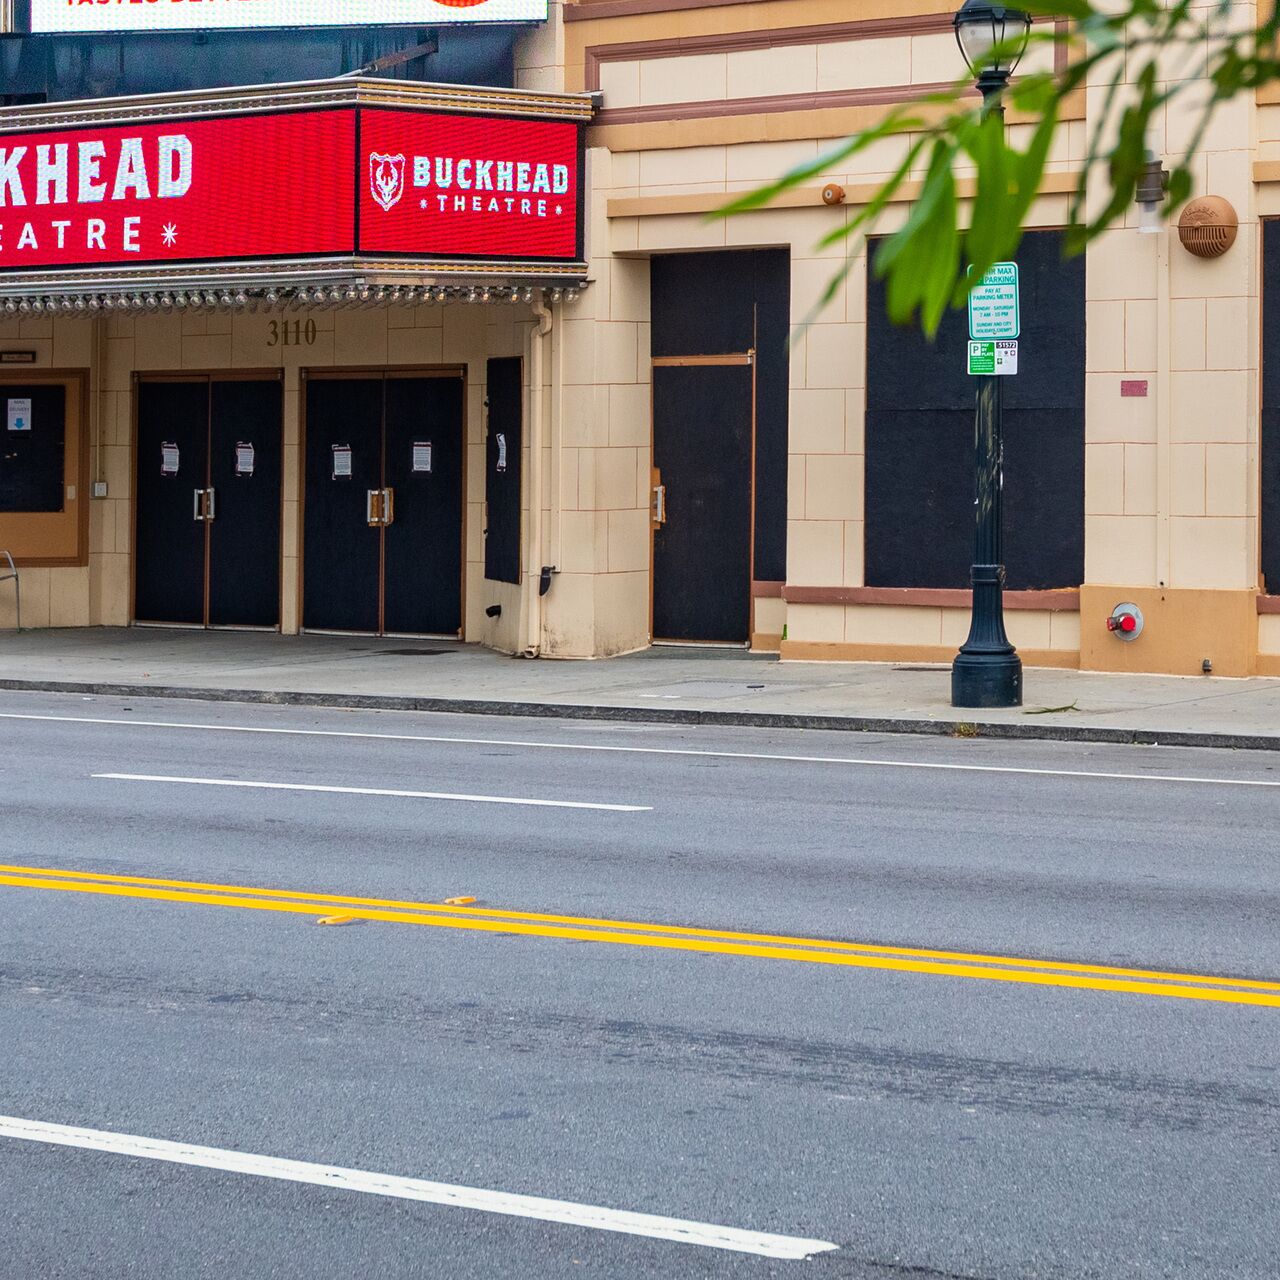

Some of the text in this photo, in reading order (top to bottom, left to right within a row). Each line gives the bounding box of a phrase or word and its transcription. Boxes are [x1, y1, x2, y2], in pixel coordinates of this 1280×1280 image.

[413, 155, 569, 195] BUCKHEAD
[437, 194, 547, 217] THEATRE
[998, 267, 1012, 275] MAX
[984, 275, 1015, 284] PARKING
[266, 318, 317, 346] 3110
[973, 345, 979, 354] P
